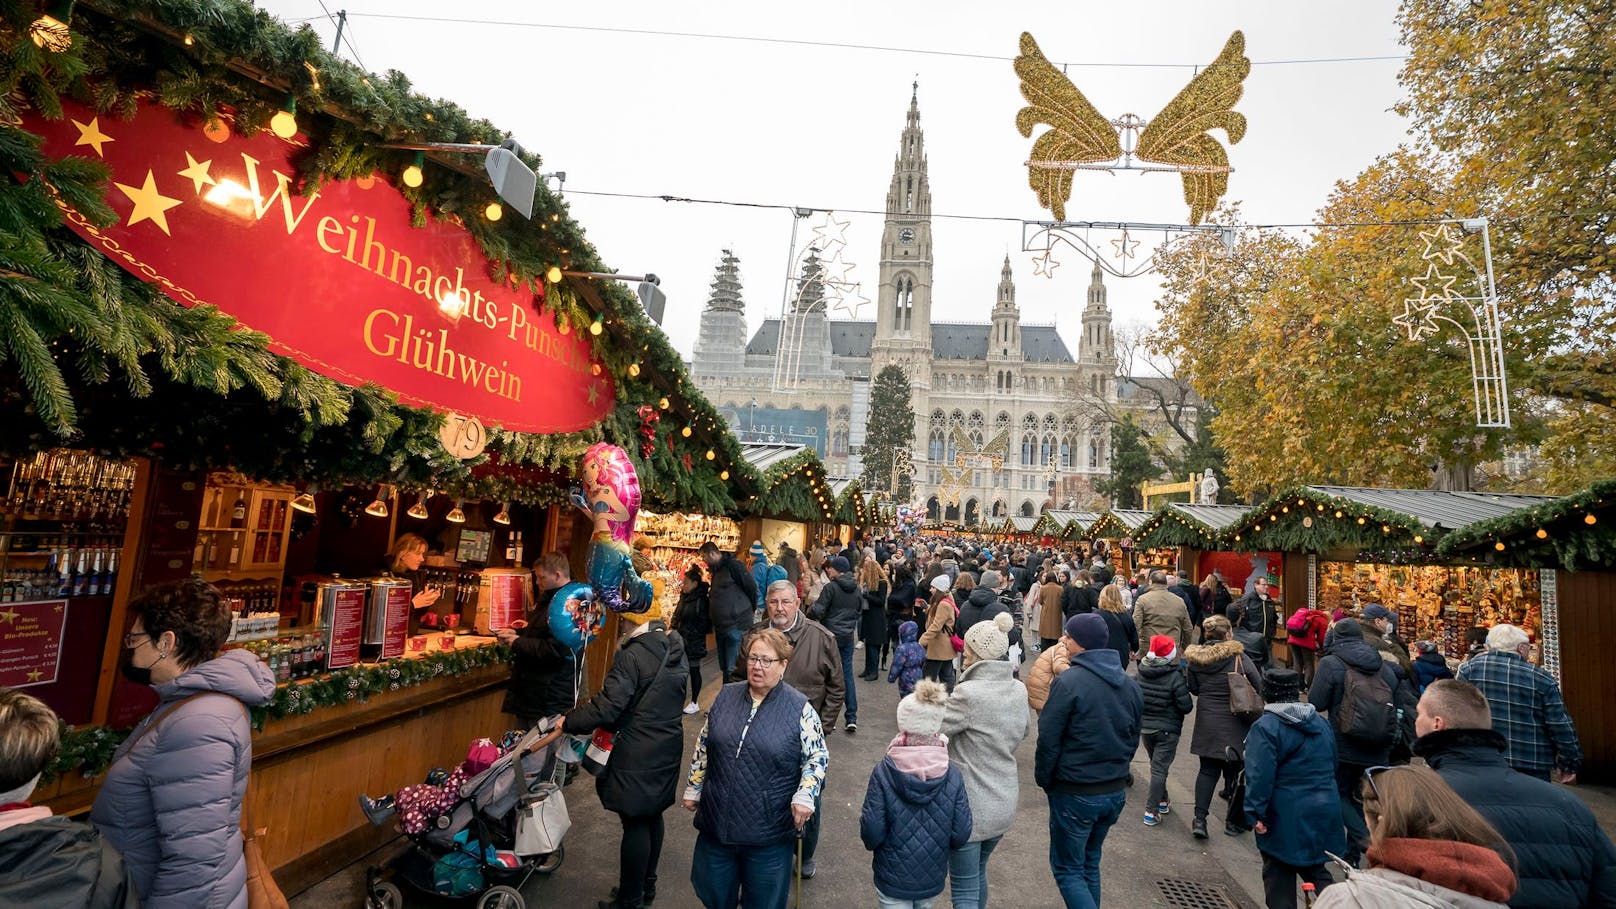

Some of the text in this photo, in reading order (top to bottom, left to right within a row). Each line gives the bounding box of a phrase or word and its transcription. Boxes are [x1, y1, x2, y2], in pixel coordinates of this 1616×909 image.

[363, 308, 522, 402] Glühwein
[454, 416, 481, 452] 79
[752, 424, 818, 435] ADELE 30
